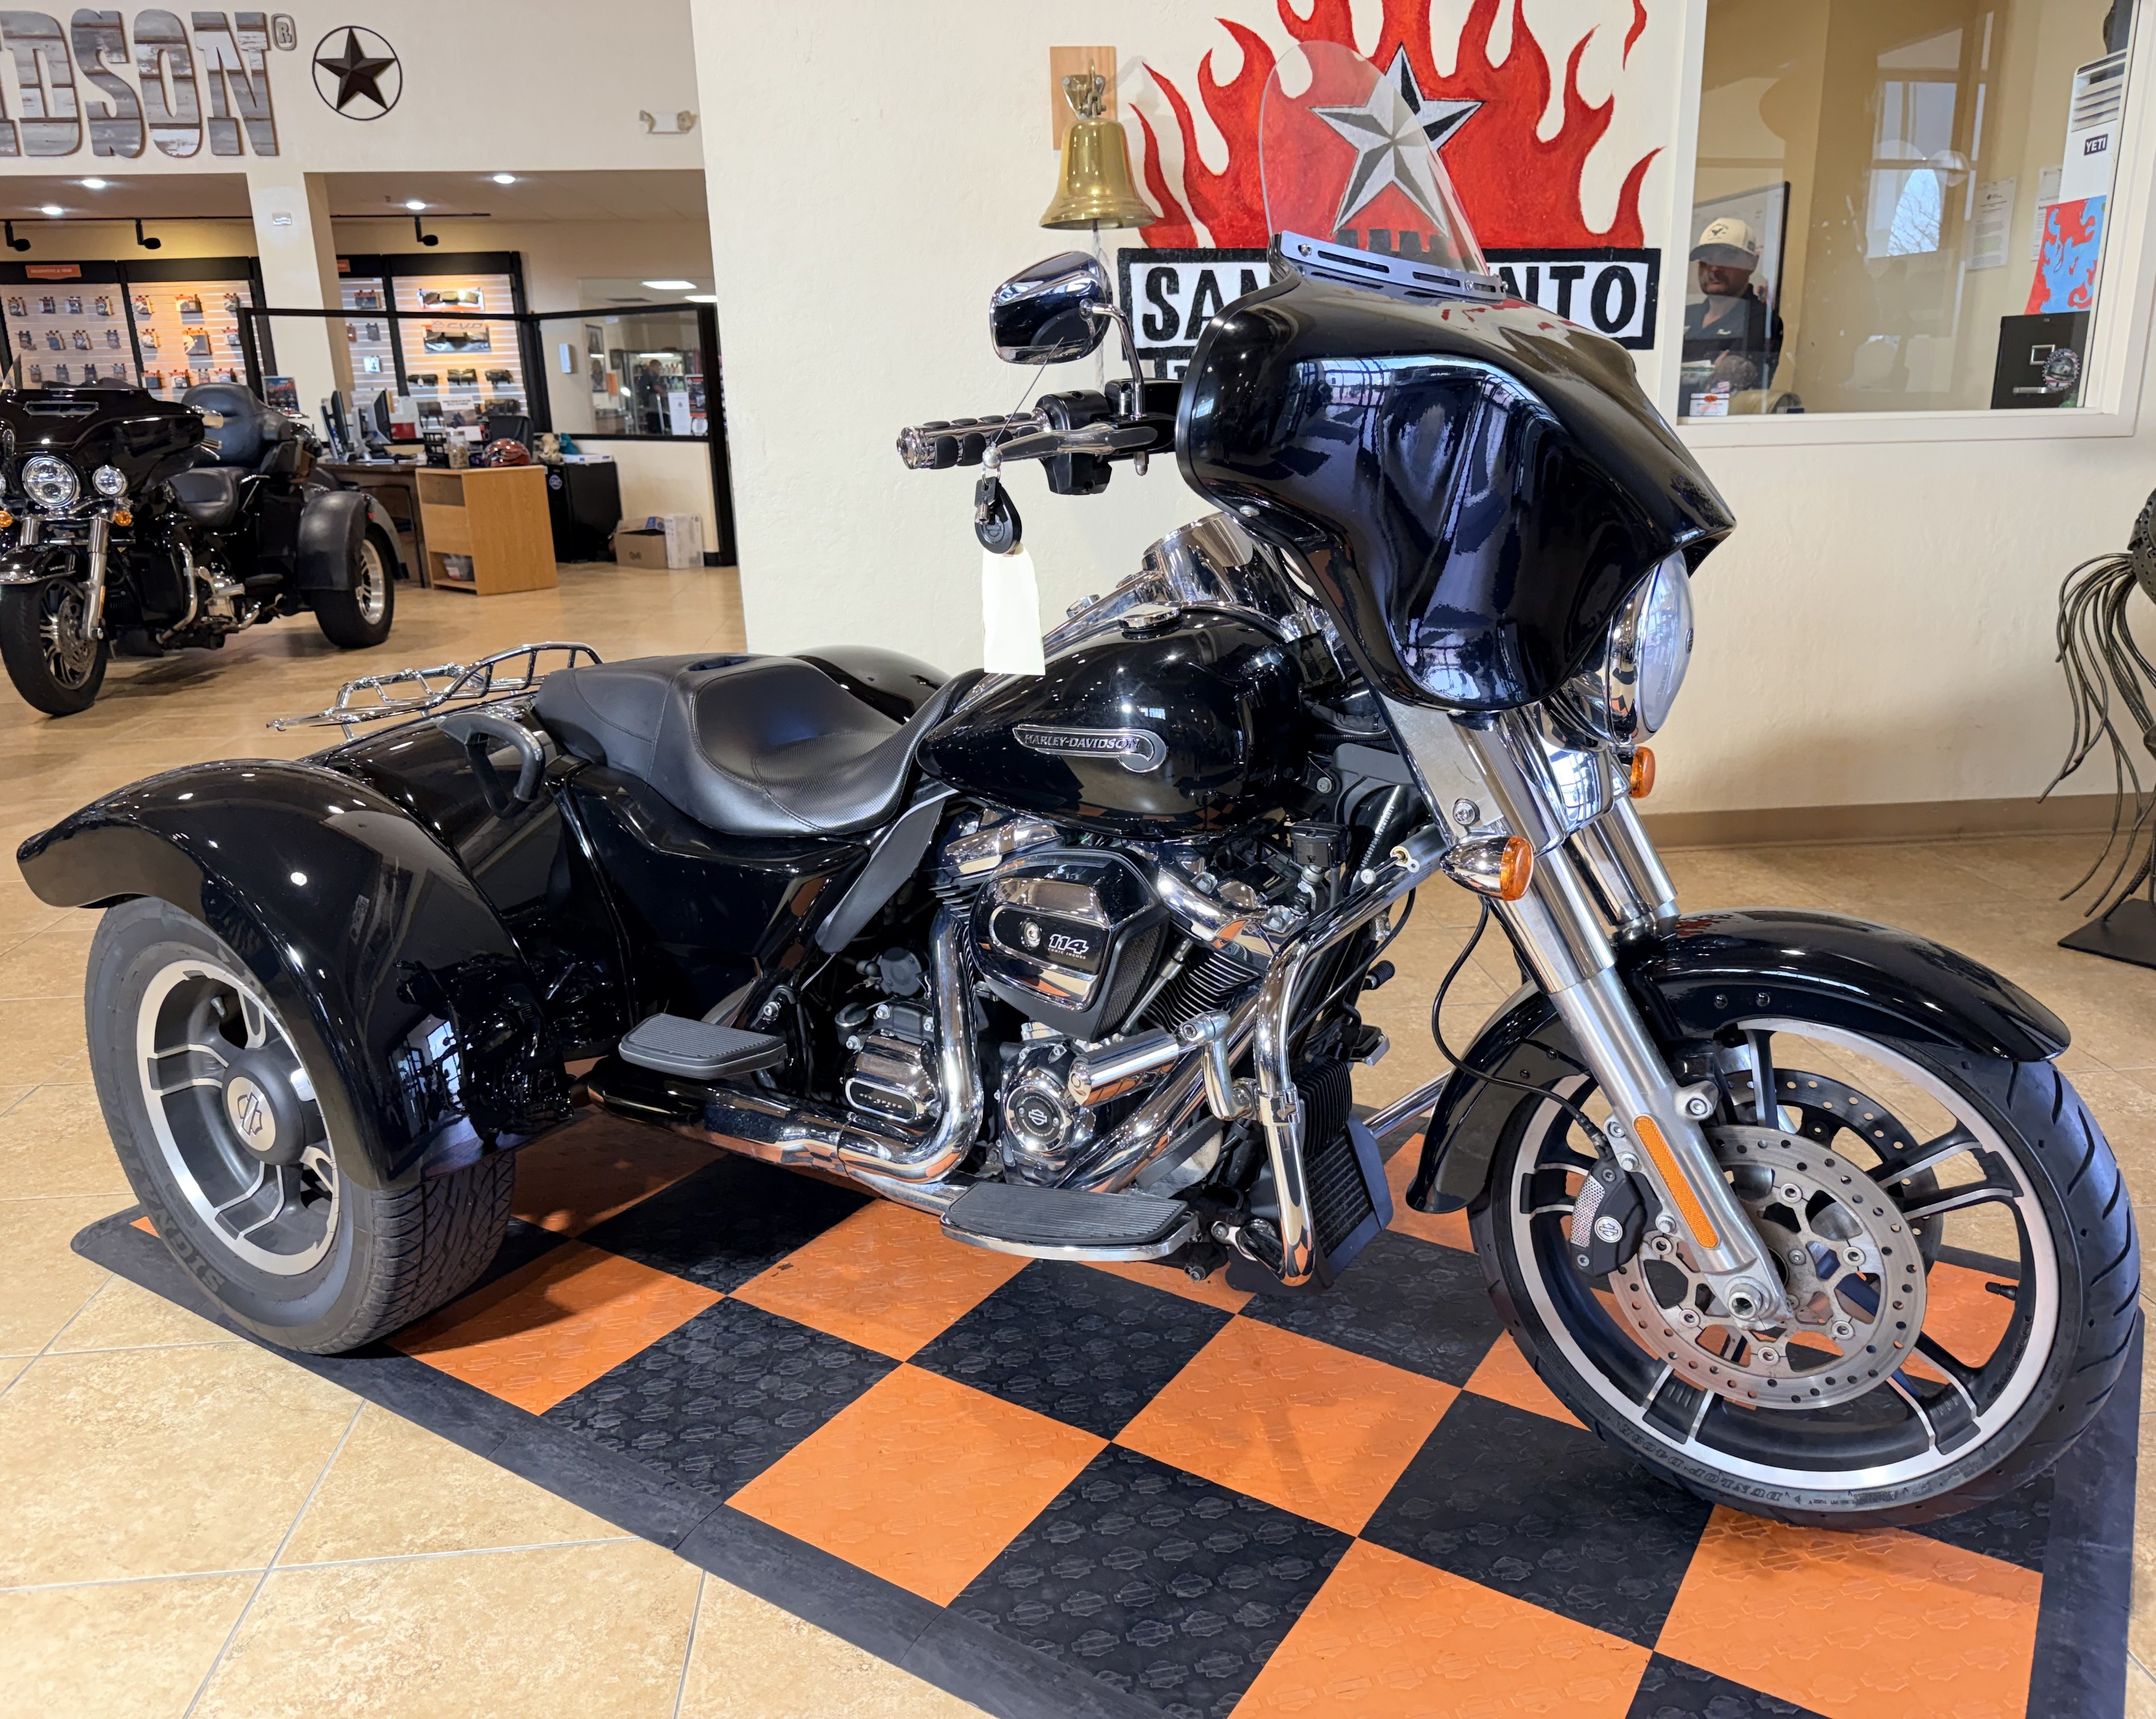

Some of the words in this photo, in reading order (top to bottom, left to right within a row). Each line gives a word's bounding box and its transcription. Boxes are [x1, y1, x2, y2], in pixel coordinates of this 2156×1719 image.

[2086, 137, 2107, 153] YETI
[1025, 734, 1140, 750] HARLEY-DAVIDSON
[1048, 933, 1089, 955] 114
[1685, 1466, 1784, 1501] DUNLOP
